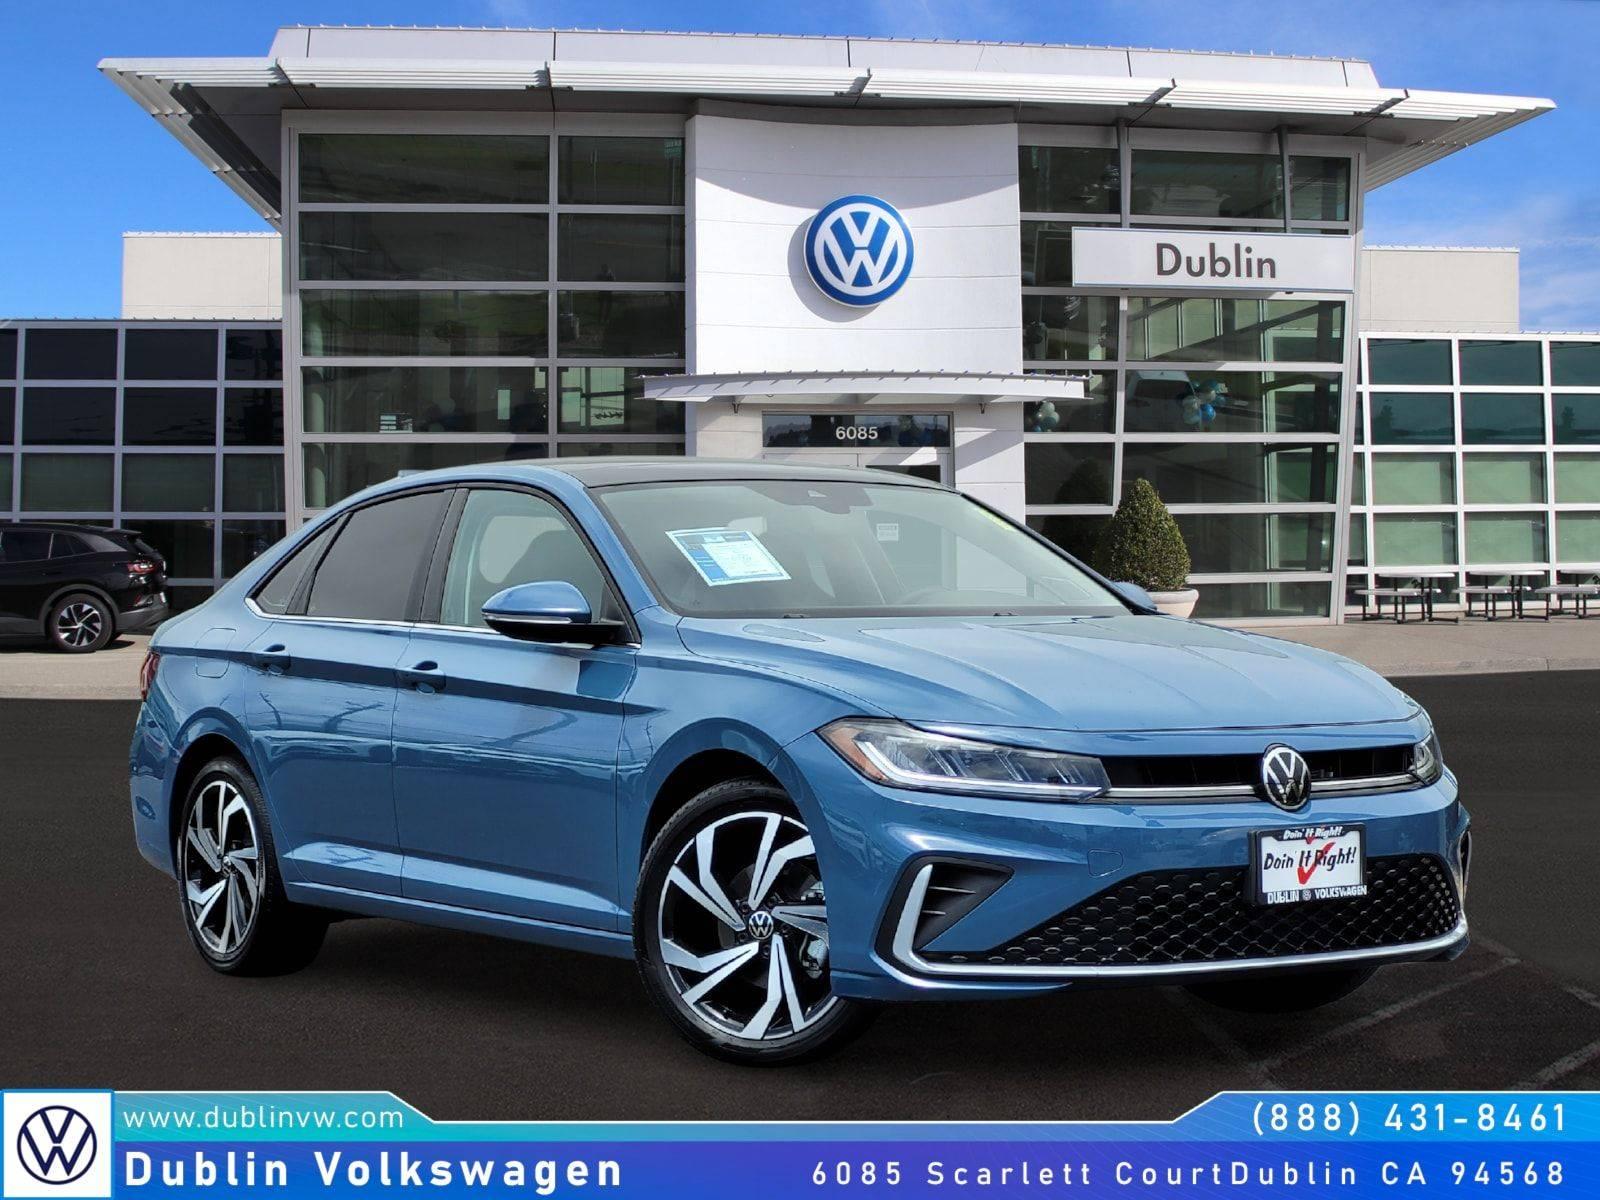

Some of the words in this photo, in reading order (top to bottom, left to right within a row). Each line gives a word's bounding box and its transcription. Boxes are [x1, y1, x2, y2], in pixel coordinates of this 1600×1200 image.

[1156, 242, 1277, 279] Dublin
[835, 426, 878, 440] 6085
[1299, 850, 1312, 867] It
[1314, 846, 1357, 872] Right!
[1267, 889, 1300, 904] DUBLIN
[1314, 885, 1368, 899] VOLKSWAGEN
